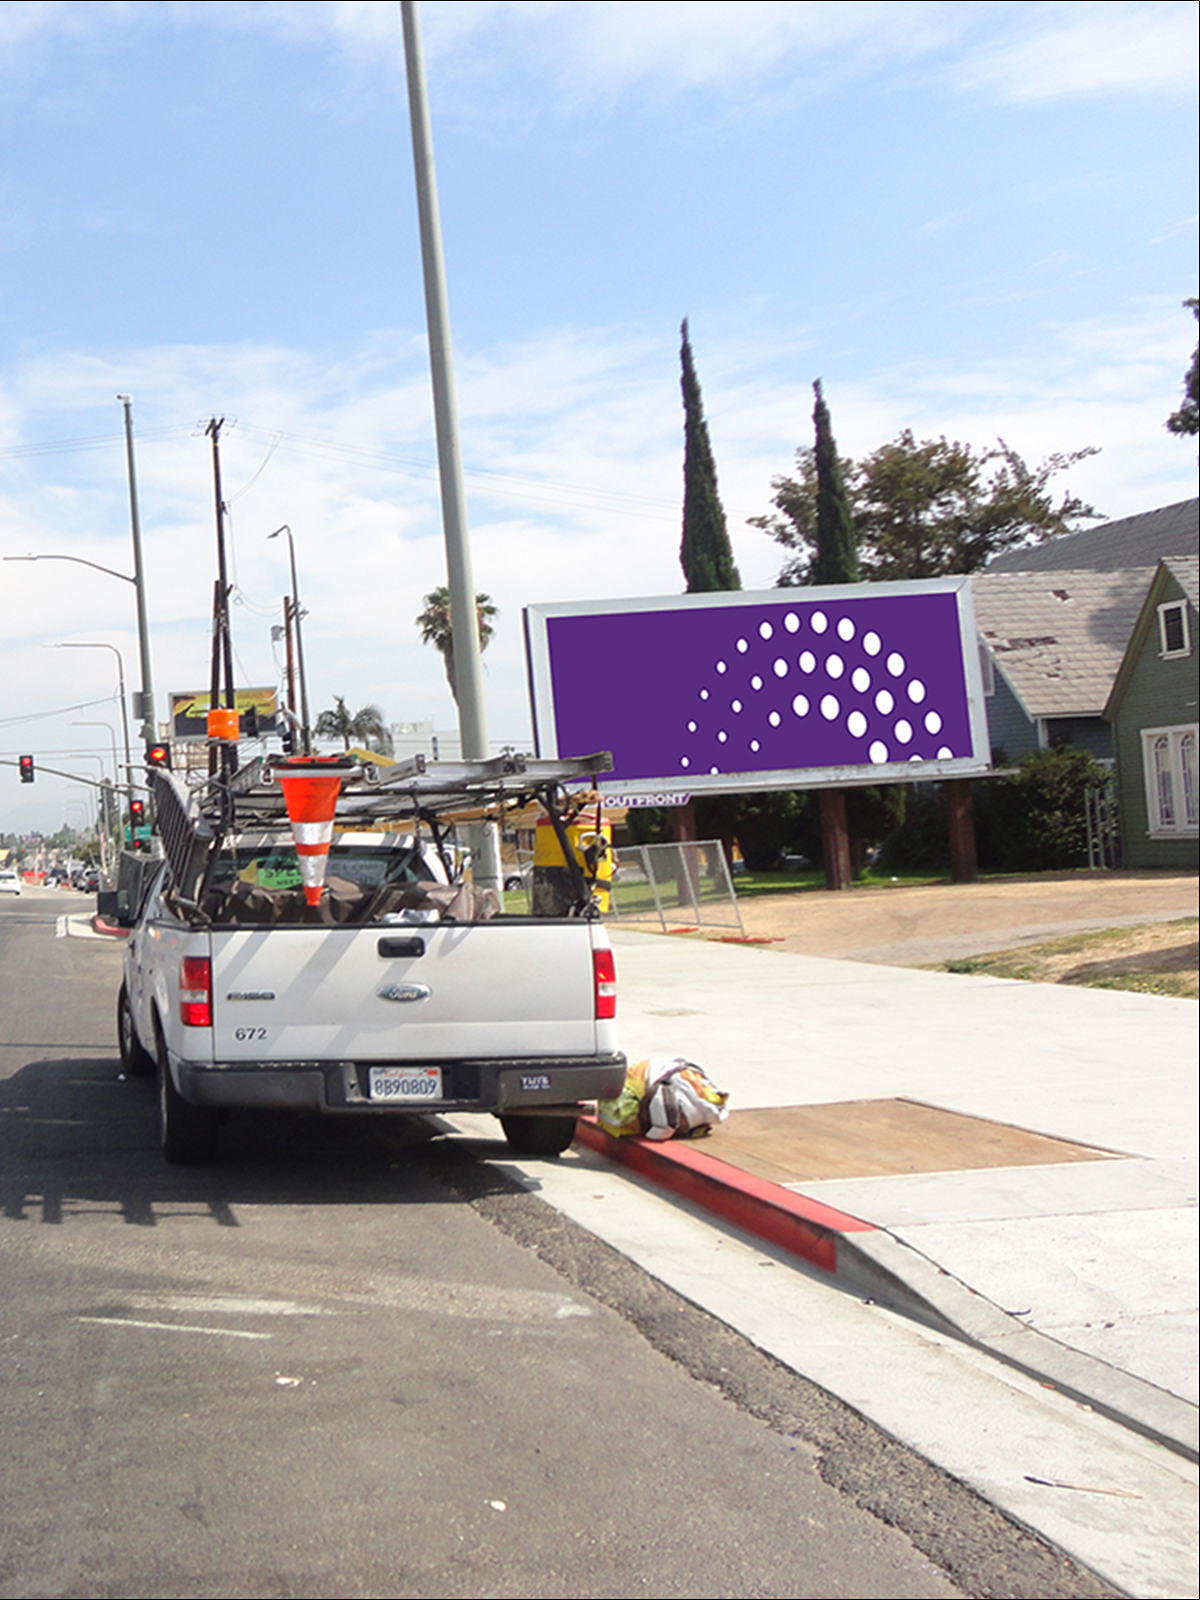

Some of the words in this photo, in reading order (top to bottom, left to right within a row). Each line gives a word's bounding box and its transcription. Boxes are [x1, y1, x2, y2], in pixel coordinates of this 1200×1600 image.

[605, 793, 683, 807] OUTFRONT
[235, 1027, 267, 1041] 672
[374, 1079, 437, 1096] 8B90809
